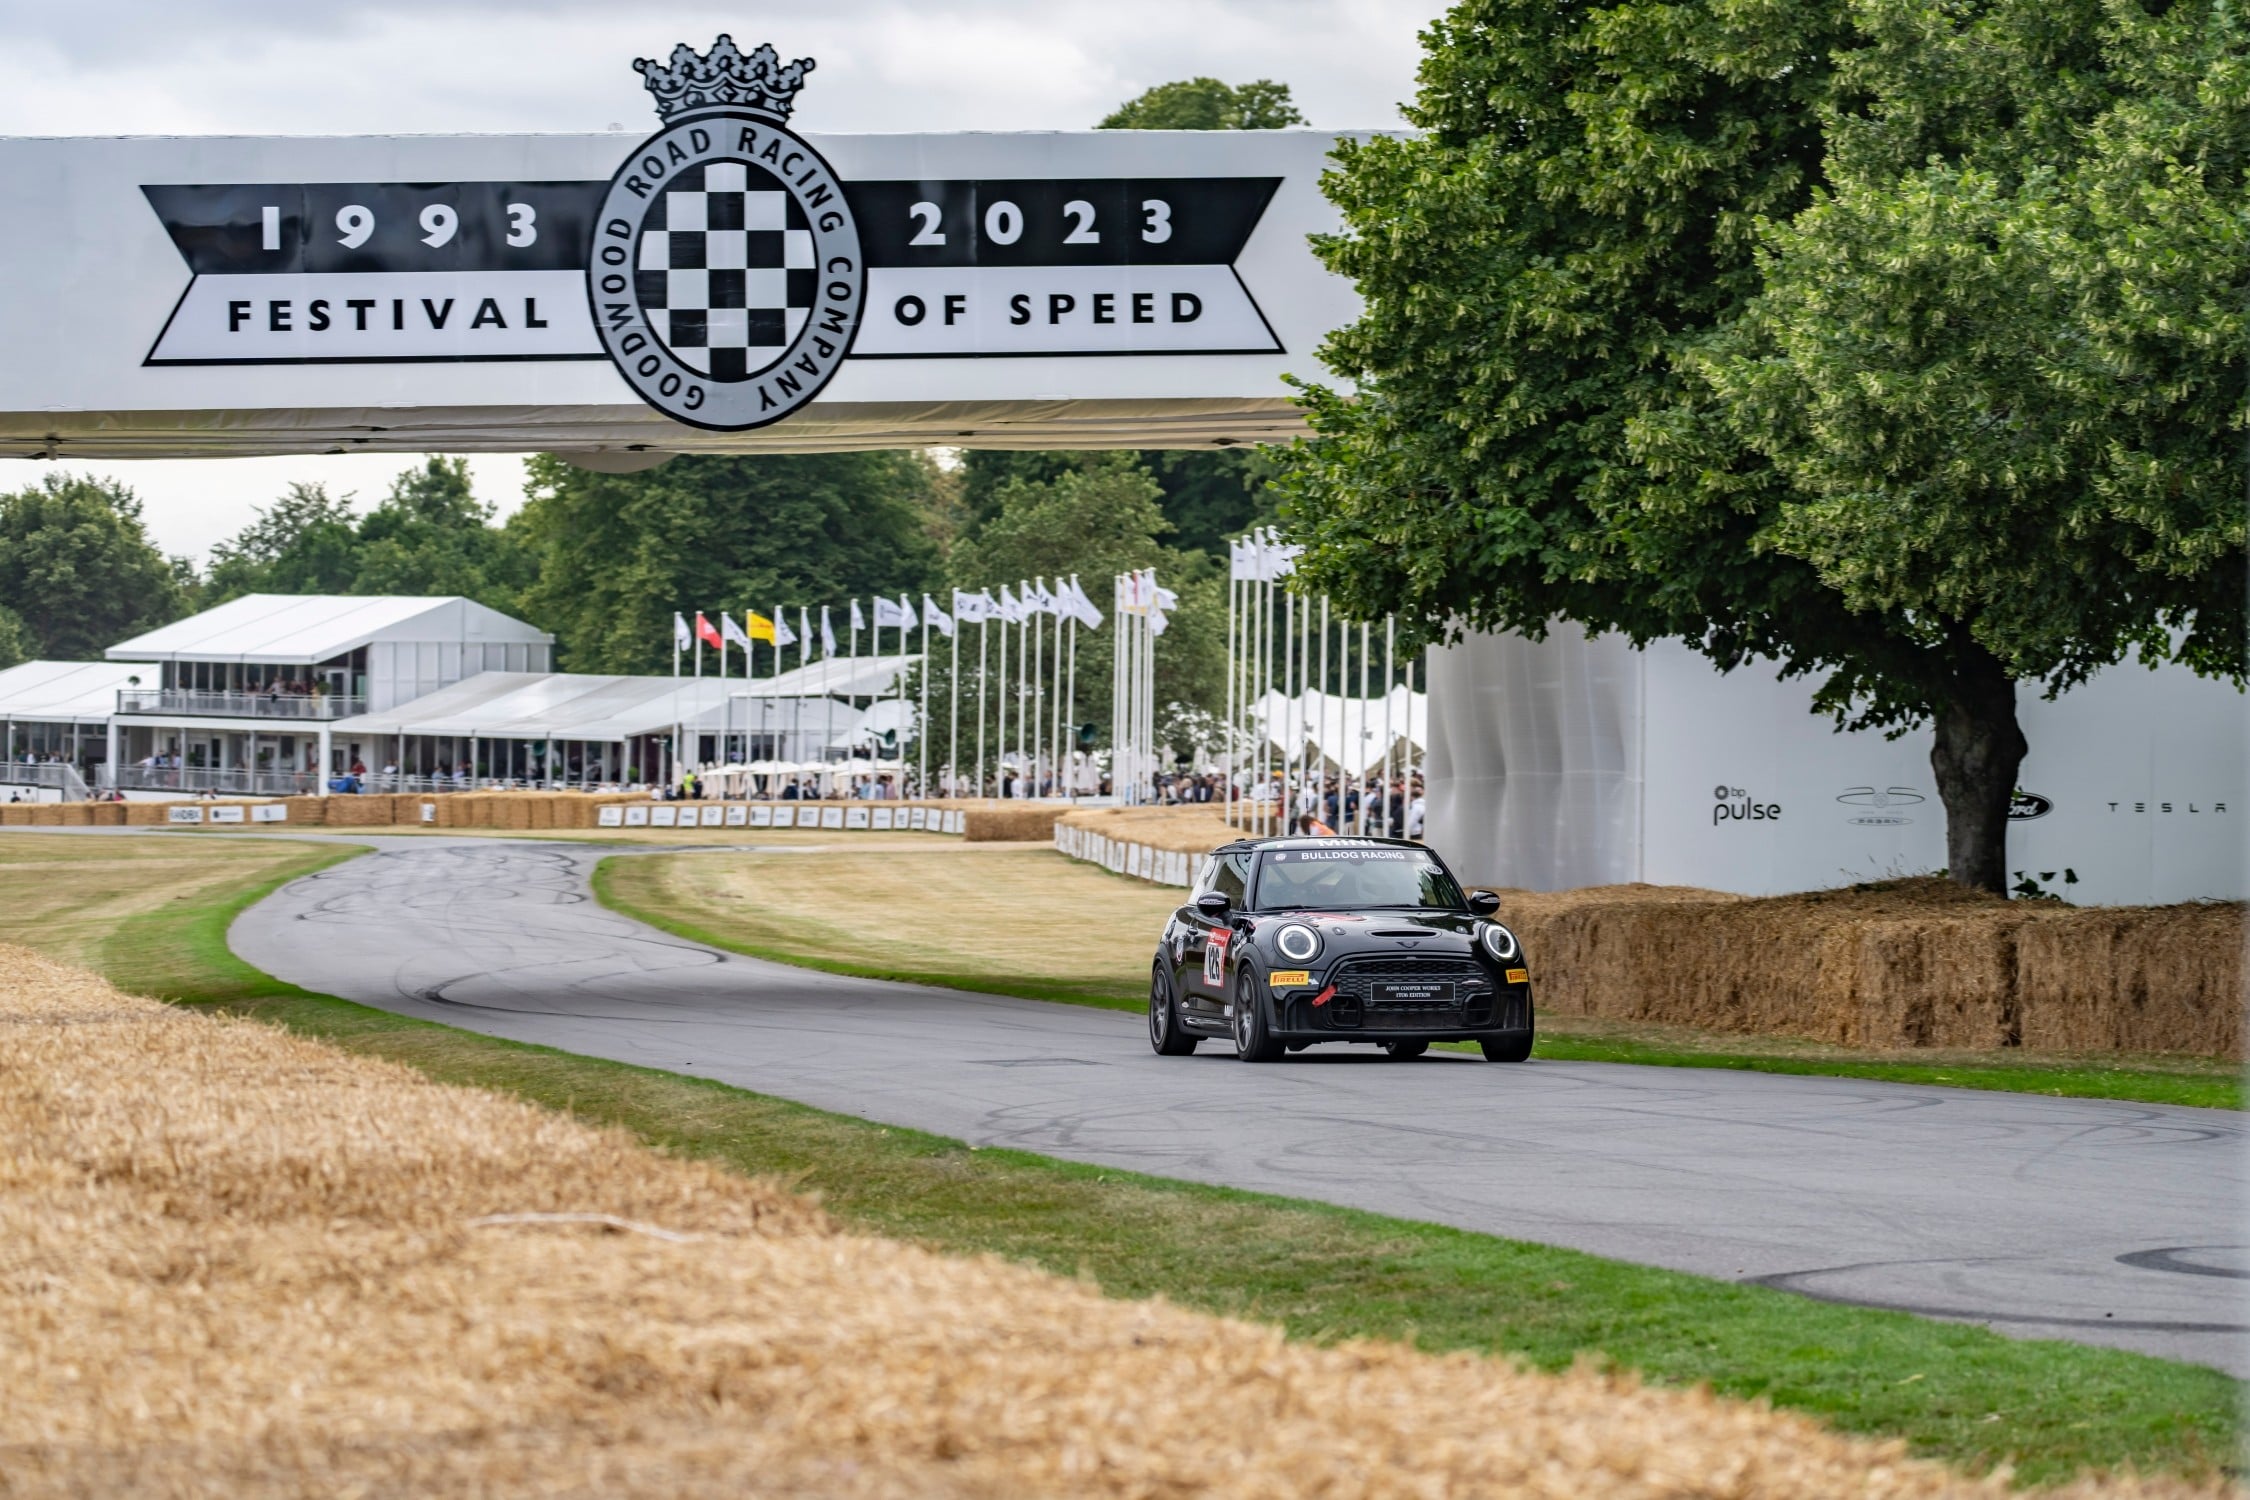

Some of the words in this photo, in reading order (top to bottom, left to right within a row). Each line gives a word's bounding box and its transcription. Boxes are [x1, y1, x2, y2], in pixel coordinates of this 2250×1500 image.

[624, 128, 711, 198] ROAD
[738, 126, 845, 234] RACING
[262, 203, 538, 250] 1993
[908, 199, 1173, 246] 2023
[228, 297, 549, 332] FESTIVAL
[602, 218, 705, 411] GOODWOOD
[894, 294, 966, 326] OF
[1010, 292, 1203, 325] SPEED
[759, 255, 852, 412] COMPANY
[1731, 787, 1746, 799] bp
[2107, 802, 2227, 813] TESLA
[1714, 797, 1782, 826] pulse
[1301, 852, 1359, 860] BULLDOG
[1361, 852, 1405, 860] RACING
[1208, 946, 1220, 980] 126
[1272, 974, 1305, 984] PIRELLI
